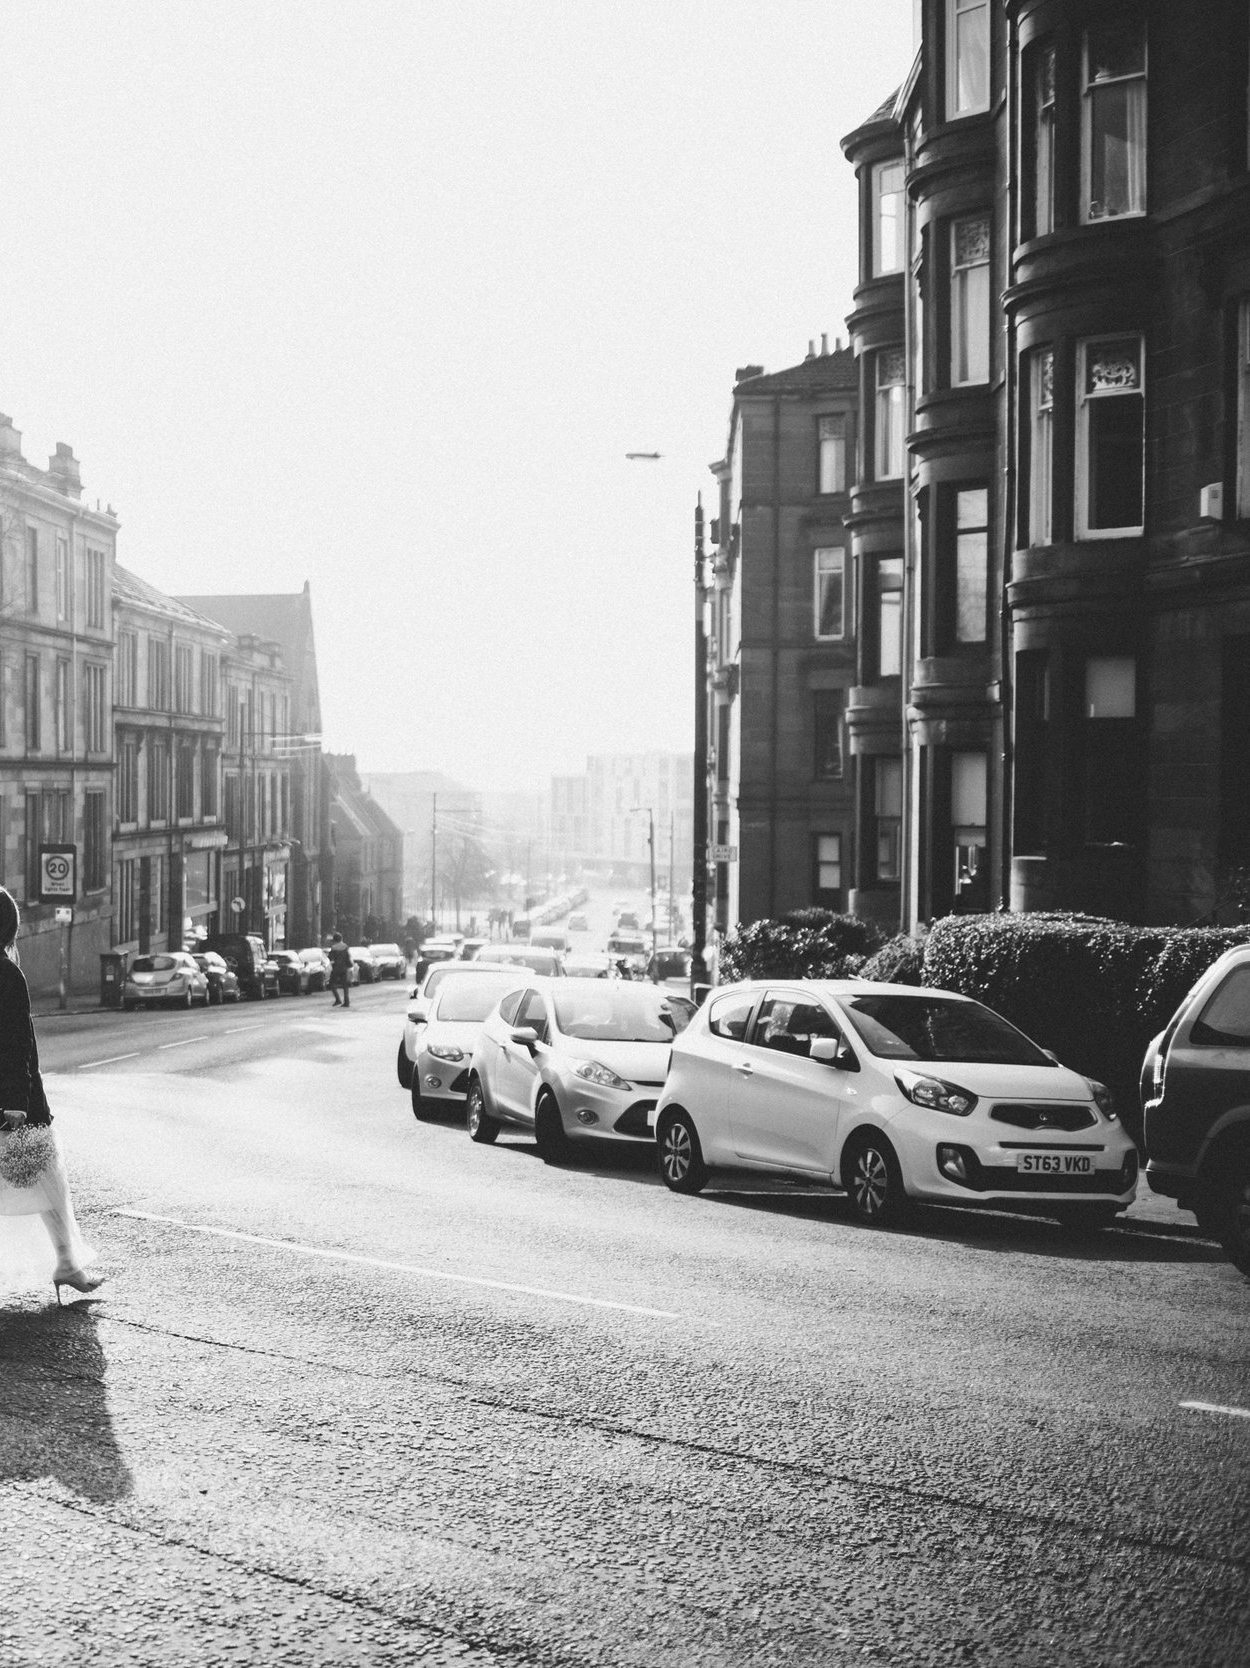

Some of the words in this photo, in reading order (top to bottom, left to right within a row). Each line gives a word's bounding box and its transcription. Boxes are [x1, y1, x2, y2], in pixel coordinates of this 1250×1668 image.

[49, 862, 66, 873] 20
[1023, 1155, 1061, 1171] ST63
[1064, 1156, 1091, 1172] VKD
